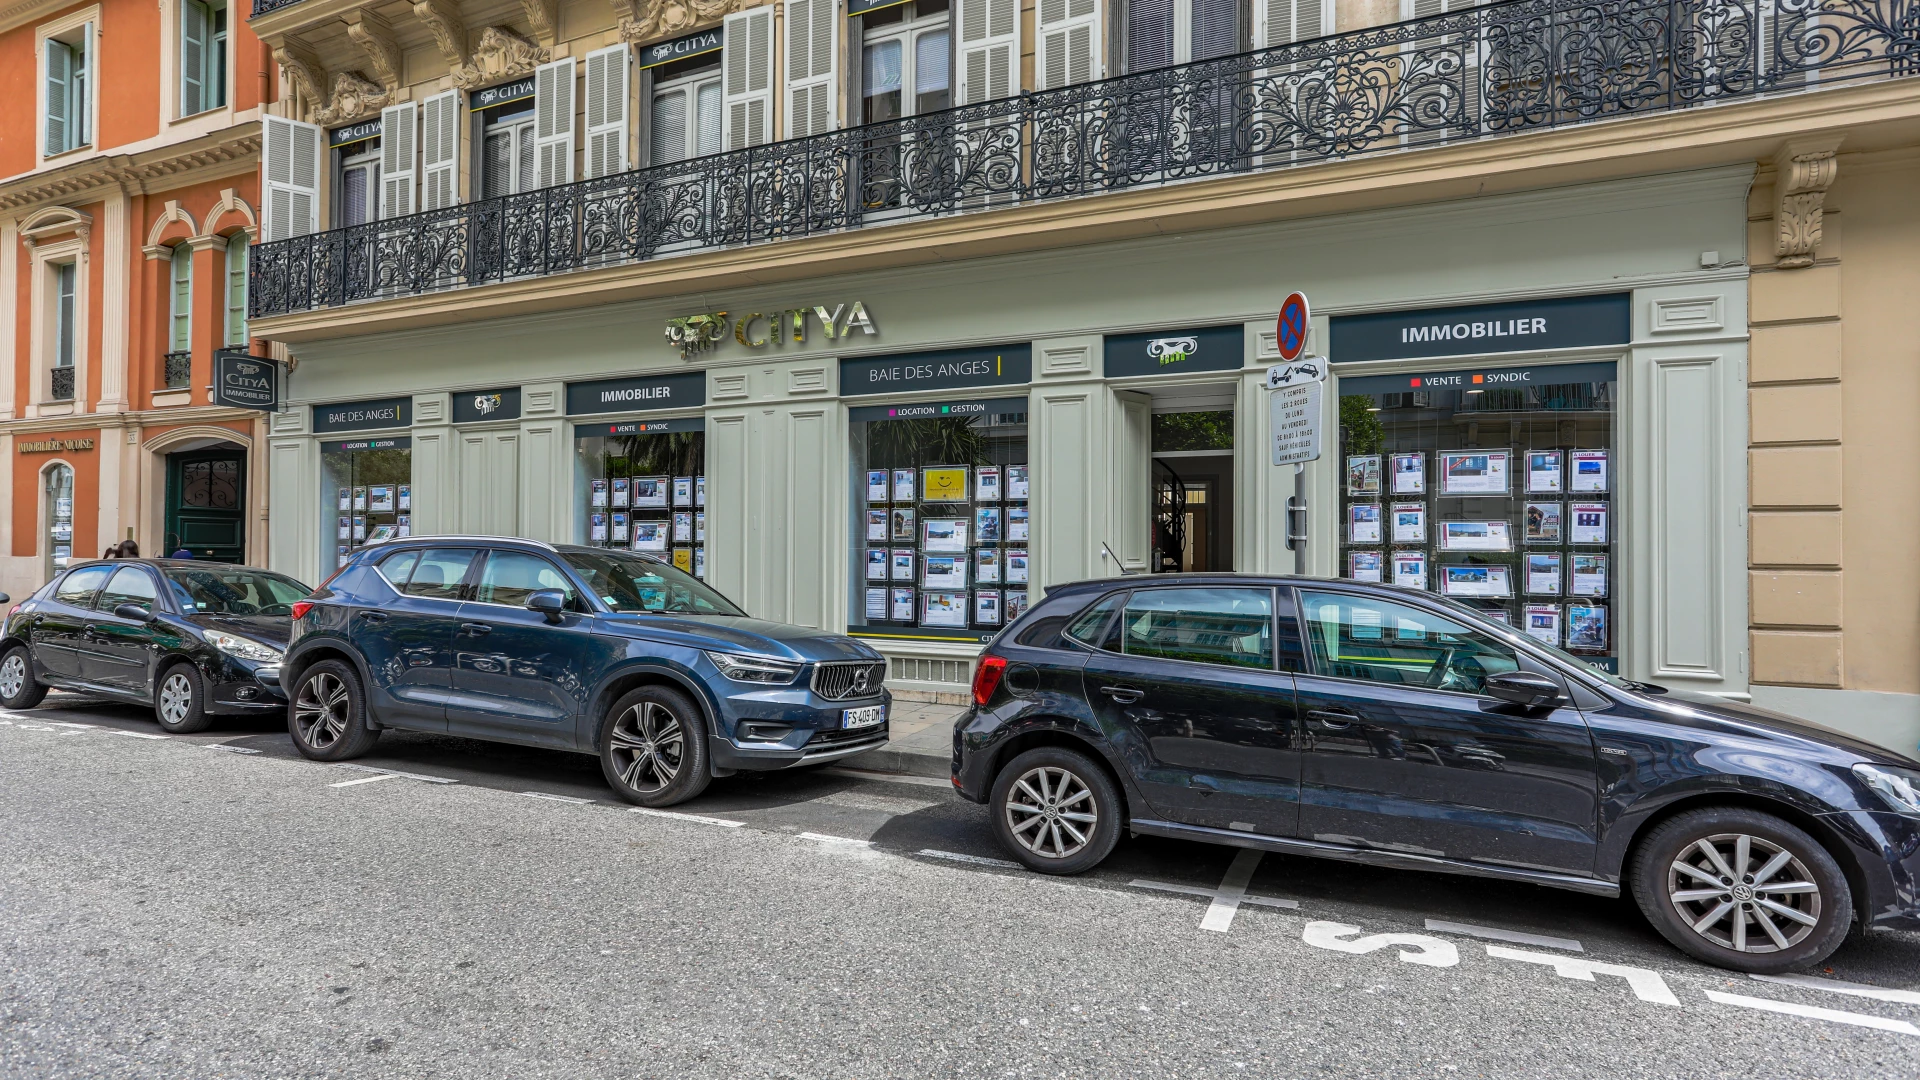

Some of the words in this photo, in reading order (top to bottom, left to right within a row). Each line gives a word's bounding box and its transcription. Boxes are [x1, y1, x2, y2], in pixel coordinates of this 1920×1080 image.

[674, 33, 718, 54] CITYA
[498, 81, 534, 99] CITYA
[353, 121, 382, 137] CITYA
[734, 300, 877, 347] CITYA
[1402, 317, 1547, 343] IMMOBILIER
[869, 367, 901, 382] BAIE
[904, 364, 933, 380] DES
[937, 360, 990, 377] ANGES
[225, 373, 270, 389] CITYA
[1425, 375, 1462, 387] VENTE
[1486, 371, 1531, 383] SYNDIC
[225, 388, 271, 400] IMMOBILIER
[601, 386, 671, 403] IMMOBILIER
[1287, 388, 1306, 397] COMPRIS
[898, 406, 935, 416] LOCATION
[950, 403, 985, 413] GESTION
[1281, 401, 1289, 409] LES
[328, 413, 346, 423] BAIE
[348, 411, 364, 422] DES
[365, 408, 394, 420] ANGES
[1291, 409, 1304, 418] LUNDI
[646, 423, 669, 431] SYNDIC
[1288, 418, 1309, 428] VENDREDI
[375, 440, 395, 448] GESTION
